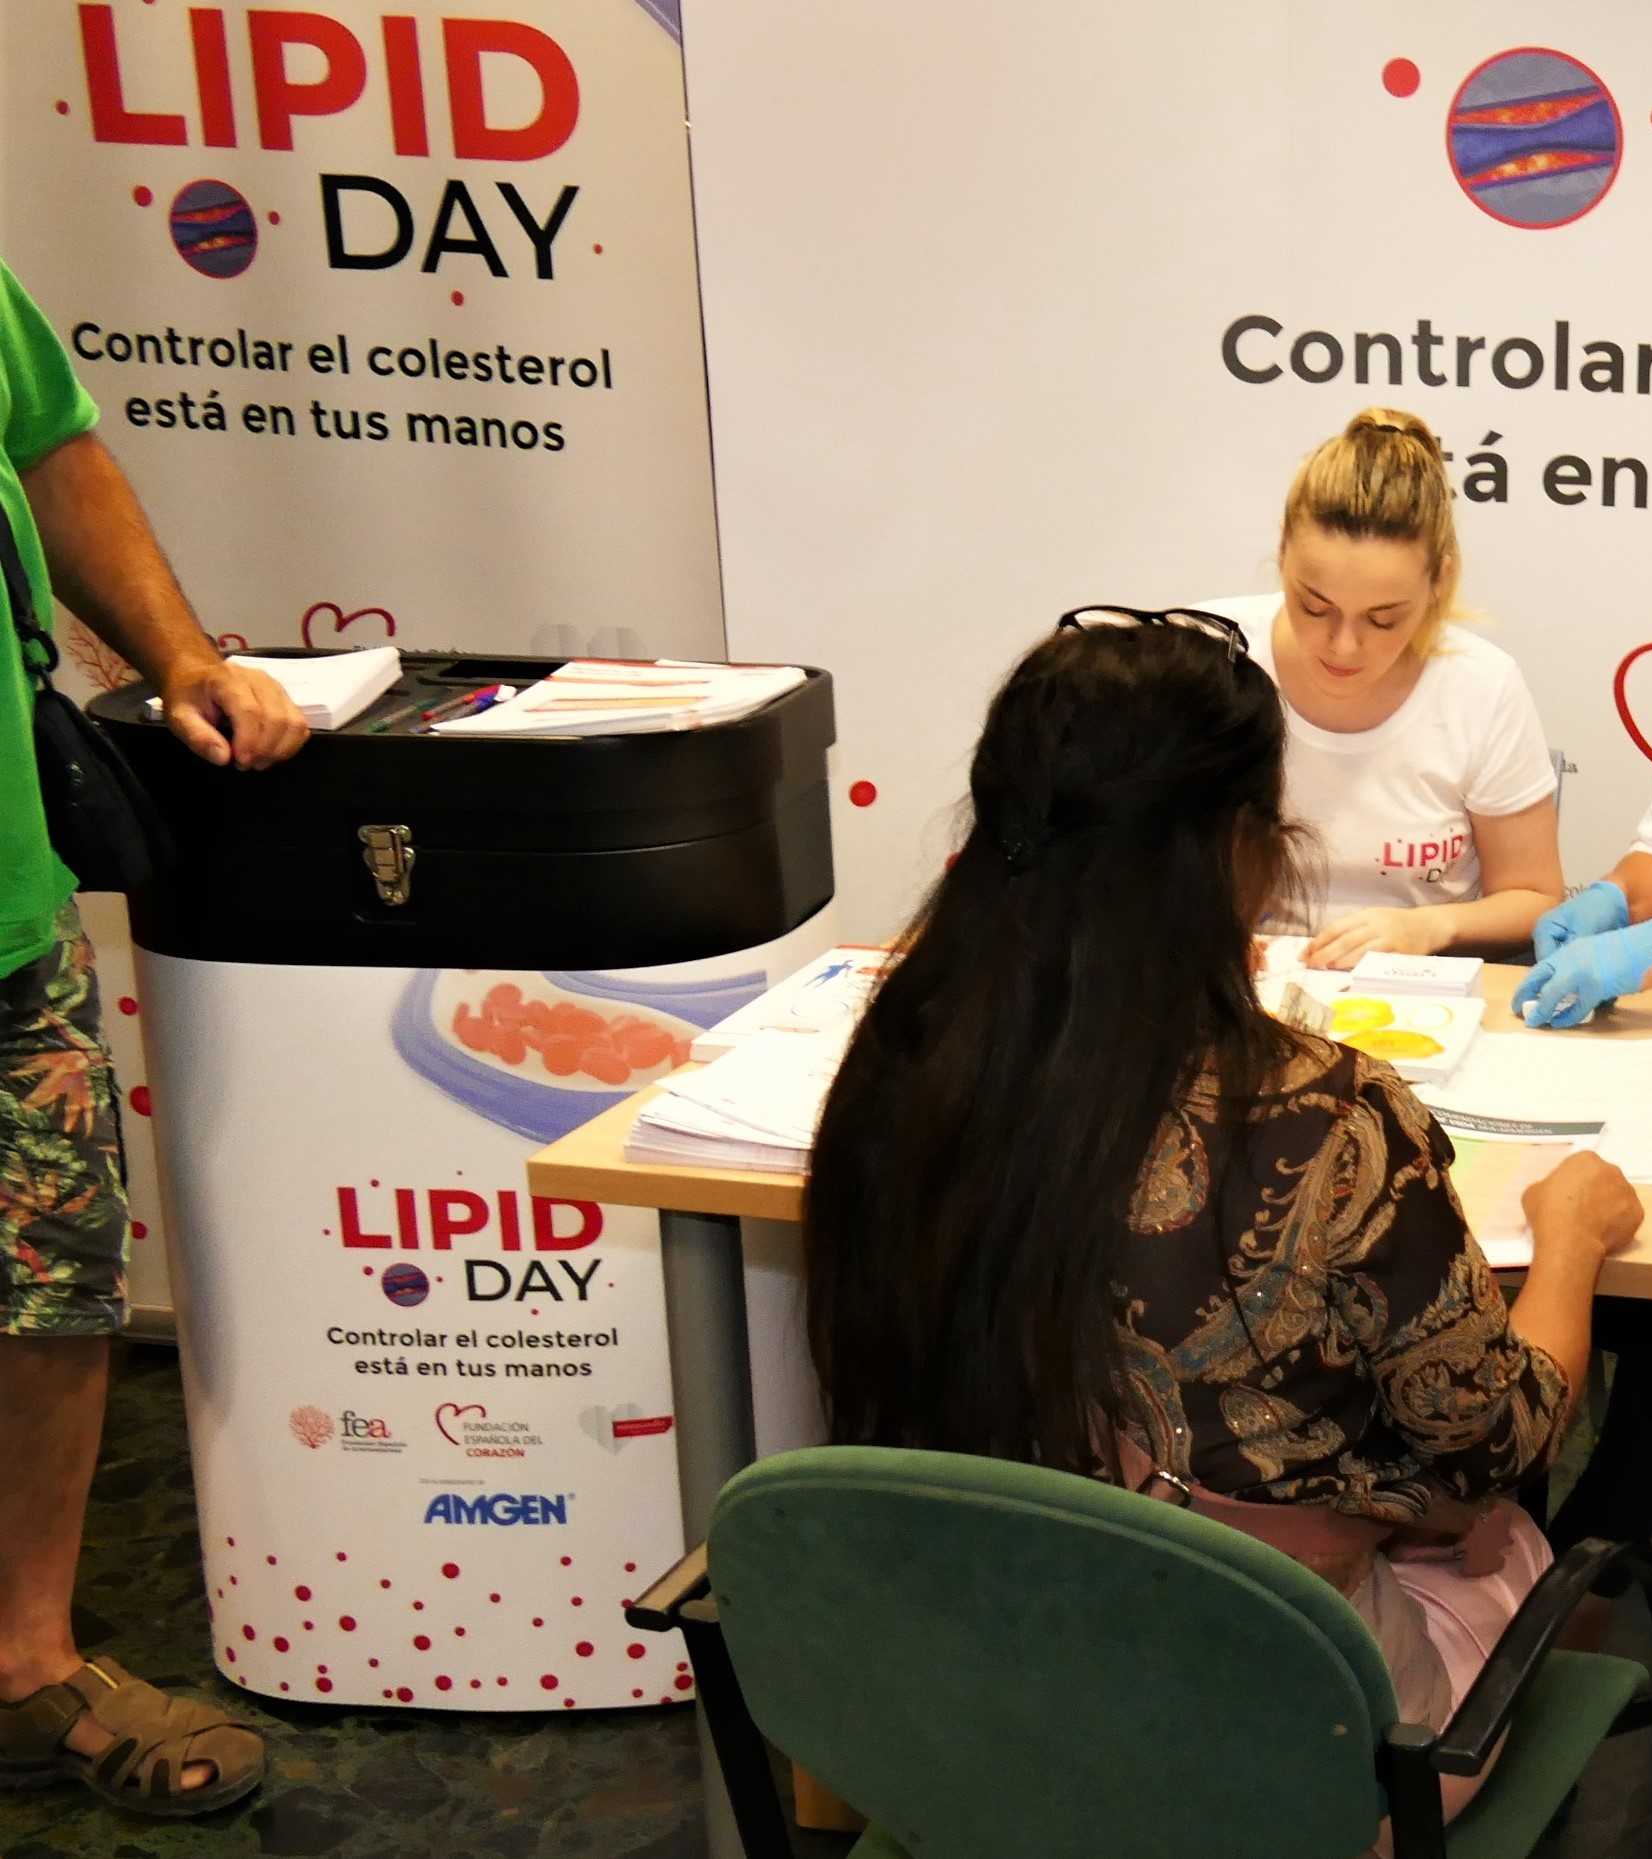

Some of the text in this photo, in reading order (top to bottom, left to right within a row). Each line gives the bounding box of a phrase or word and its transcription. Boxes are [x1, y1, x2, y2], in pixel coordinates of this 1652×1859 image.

[78, 3, 581, 162] LIPID
[319, 173, 580, 281] DAY
[72, 322, 613, 389] Controlar el colesterol
[126, 391, 565, 452] está en tus manos
[1543, 453, 1648, 510] en
[1383, 834, 1464, 868] LIPID
[336, 1186, 604, 1252] LIPID
[464, 1259, 602, 1302] DAY
[327, 1326, 618, 1348] Controlar el colesterol
[354, 1356, 593, 1378] está en tus manos
[340, 1410, 392, 1438] fea
[424, 1494, 568, 1526] AMGEN
